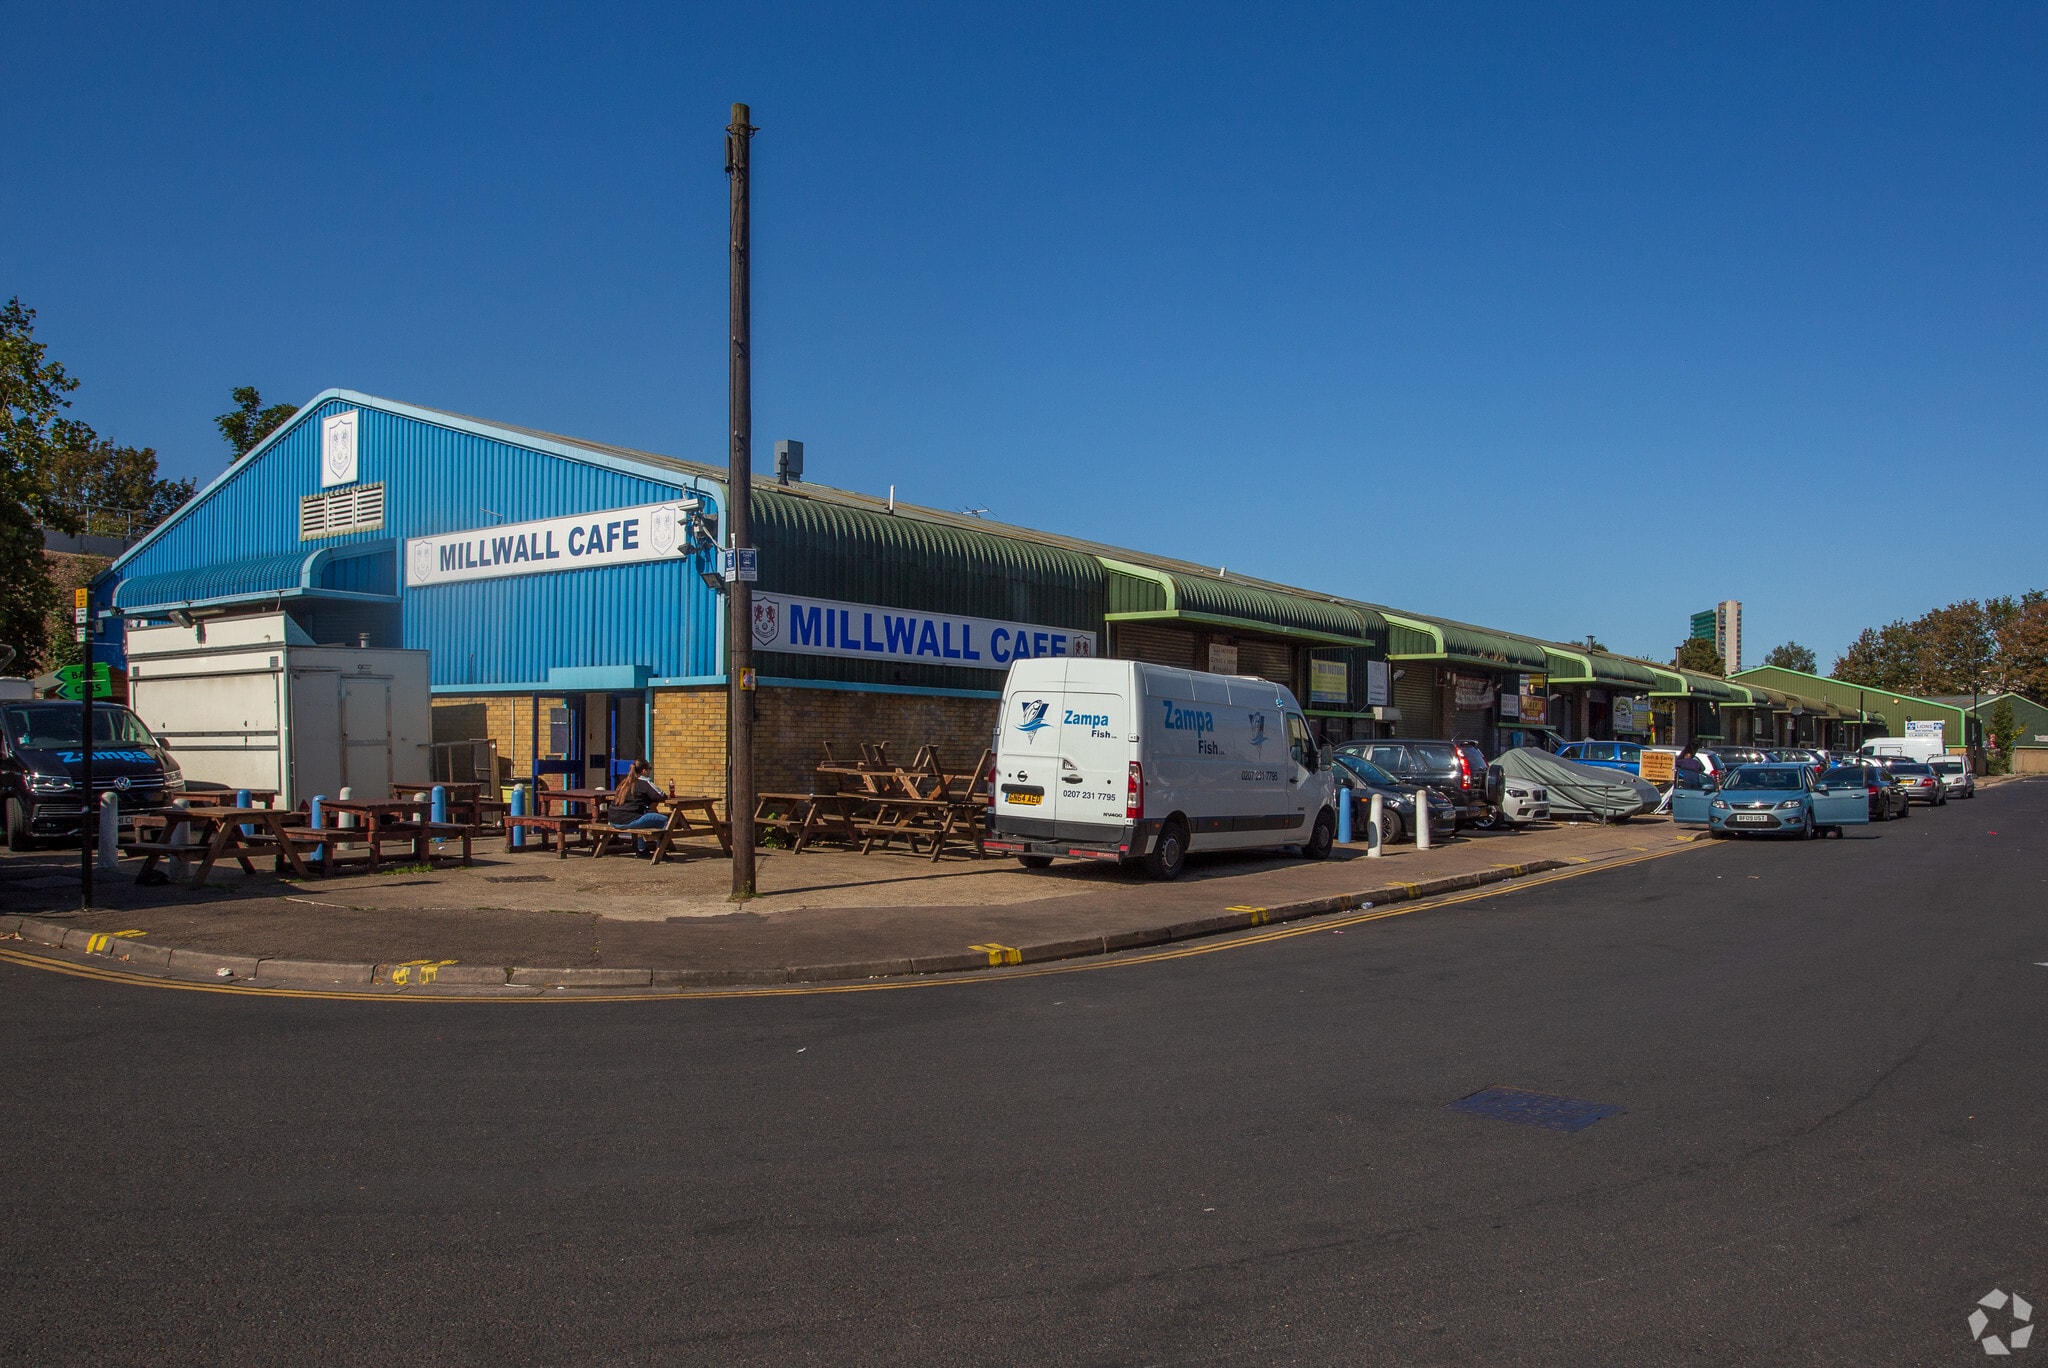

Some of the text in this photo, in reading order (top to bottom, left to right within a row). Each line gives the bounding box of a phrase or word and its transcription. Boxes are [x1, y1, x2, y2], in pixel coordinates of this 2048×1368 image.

[440, 518, 640, 572] MILLWALL CAFE
[790, 604, 1067, 663] MILLWALL CAFE
[1064, 710, 1109, 729] Zampa
[1163, 700, 1214, 738] Zampa
[1091, 730, 1111, 739] Fish
[1198, 740, 1218, 755] Fish
[1242, 770, 1254, 781] 0207
[1063, 790, 1116, 801] 0207 231 7795
